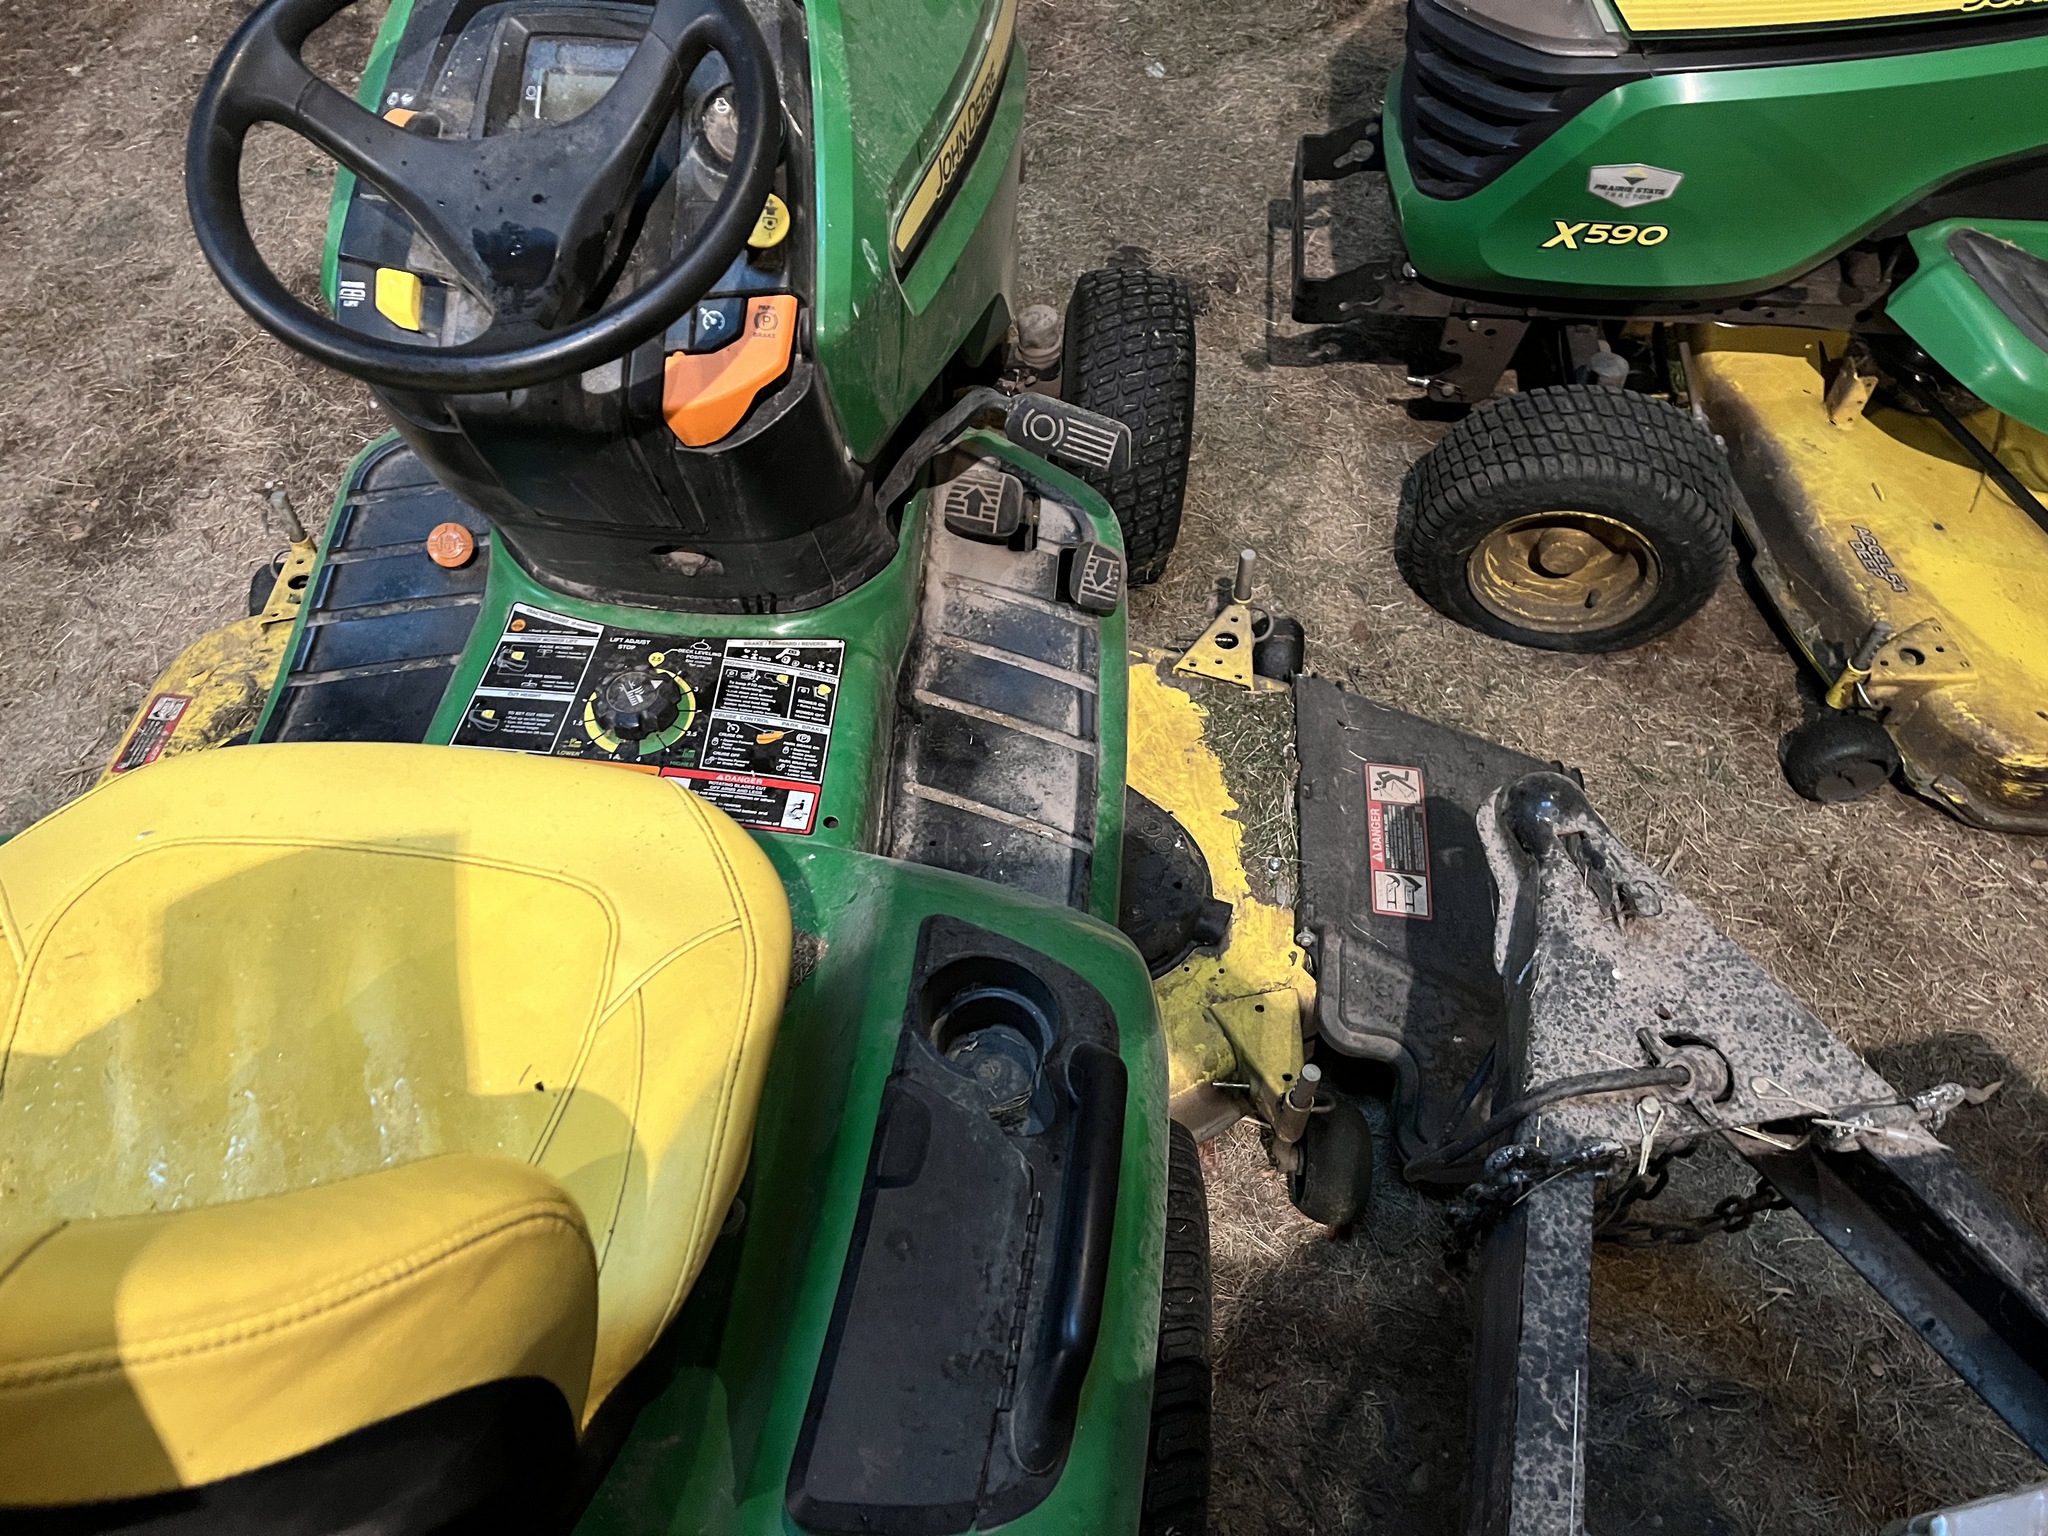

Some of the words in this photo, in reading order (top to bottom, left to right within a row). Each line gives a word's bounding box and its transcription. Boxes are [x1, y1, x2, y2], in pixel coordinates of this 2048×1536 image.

[936, 125, 968, 197] JOHN
[967, 60, 998, 141] DEERE
[1593, 184, 1633, 193] PRAIRIE
[1635, 187, 1666, 195] STATE
[1605, 192, 1652, 200] TRACTOR
[1539, 220, 1669, 250] X590
[1848, 540, 1886, 579] DEEP
[1850, 524, 1894, 574] ACCEL
[724, 775, 763, 784] DANGER
[1370, 808, 1383, 850] DANGER
